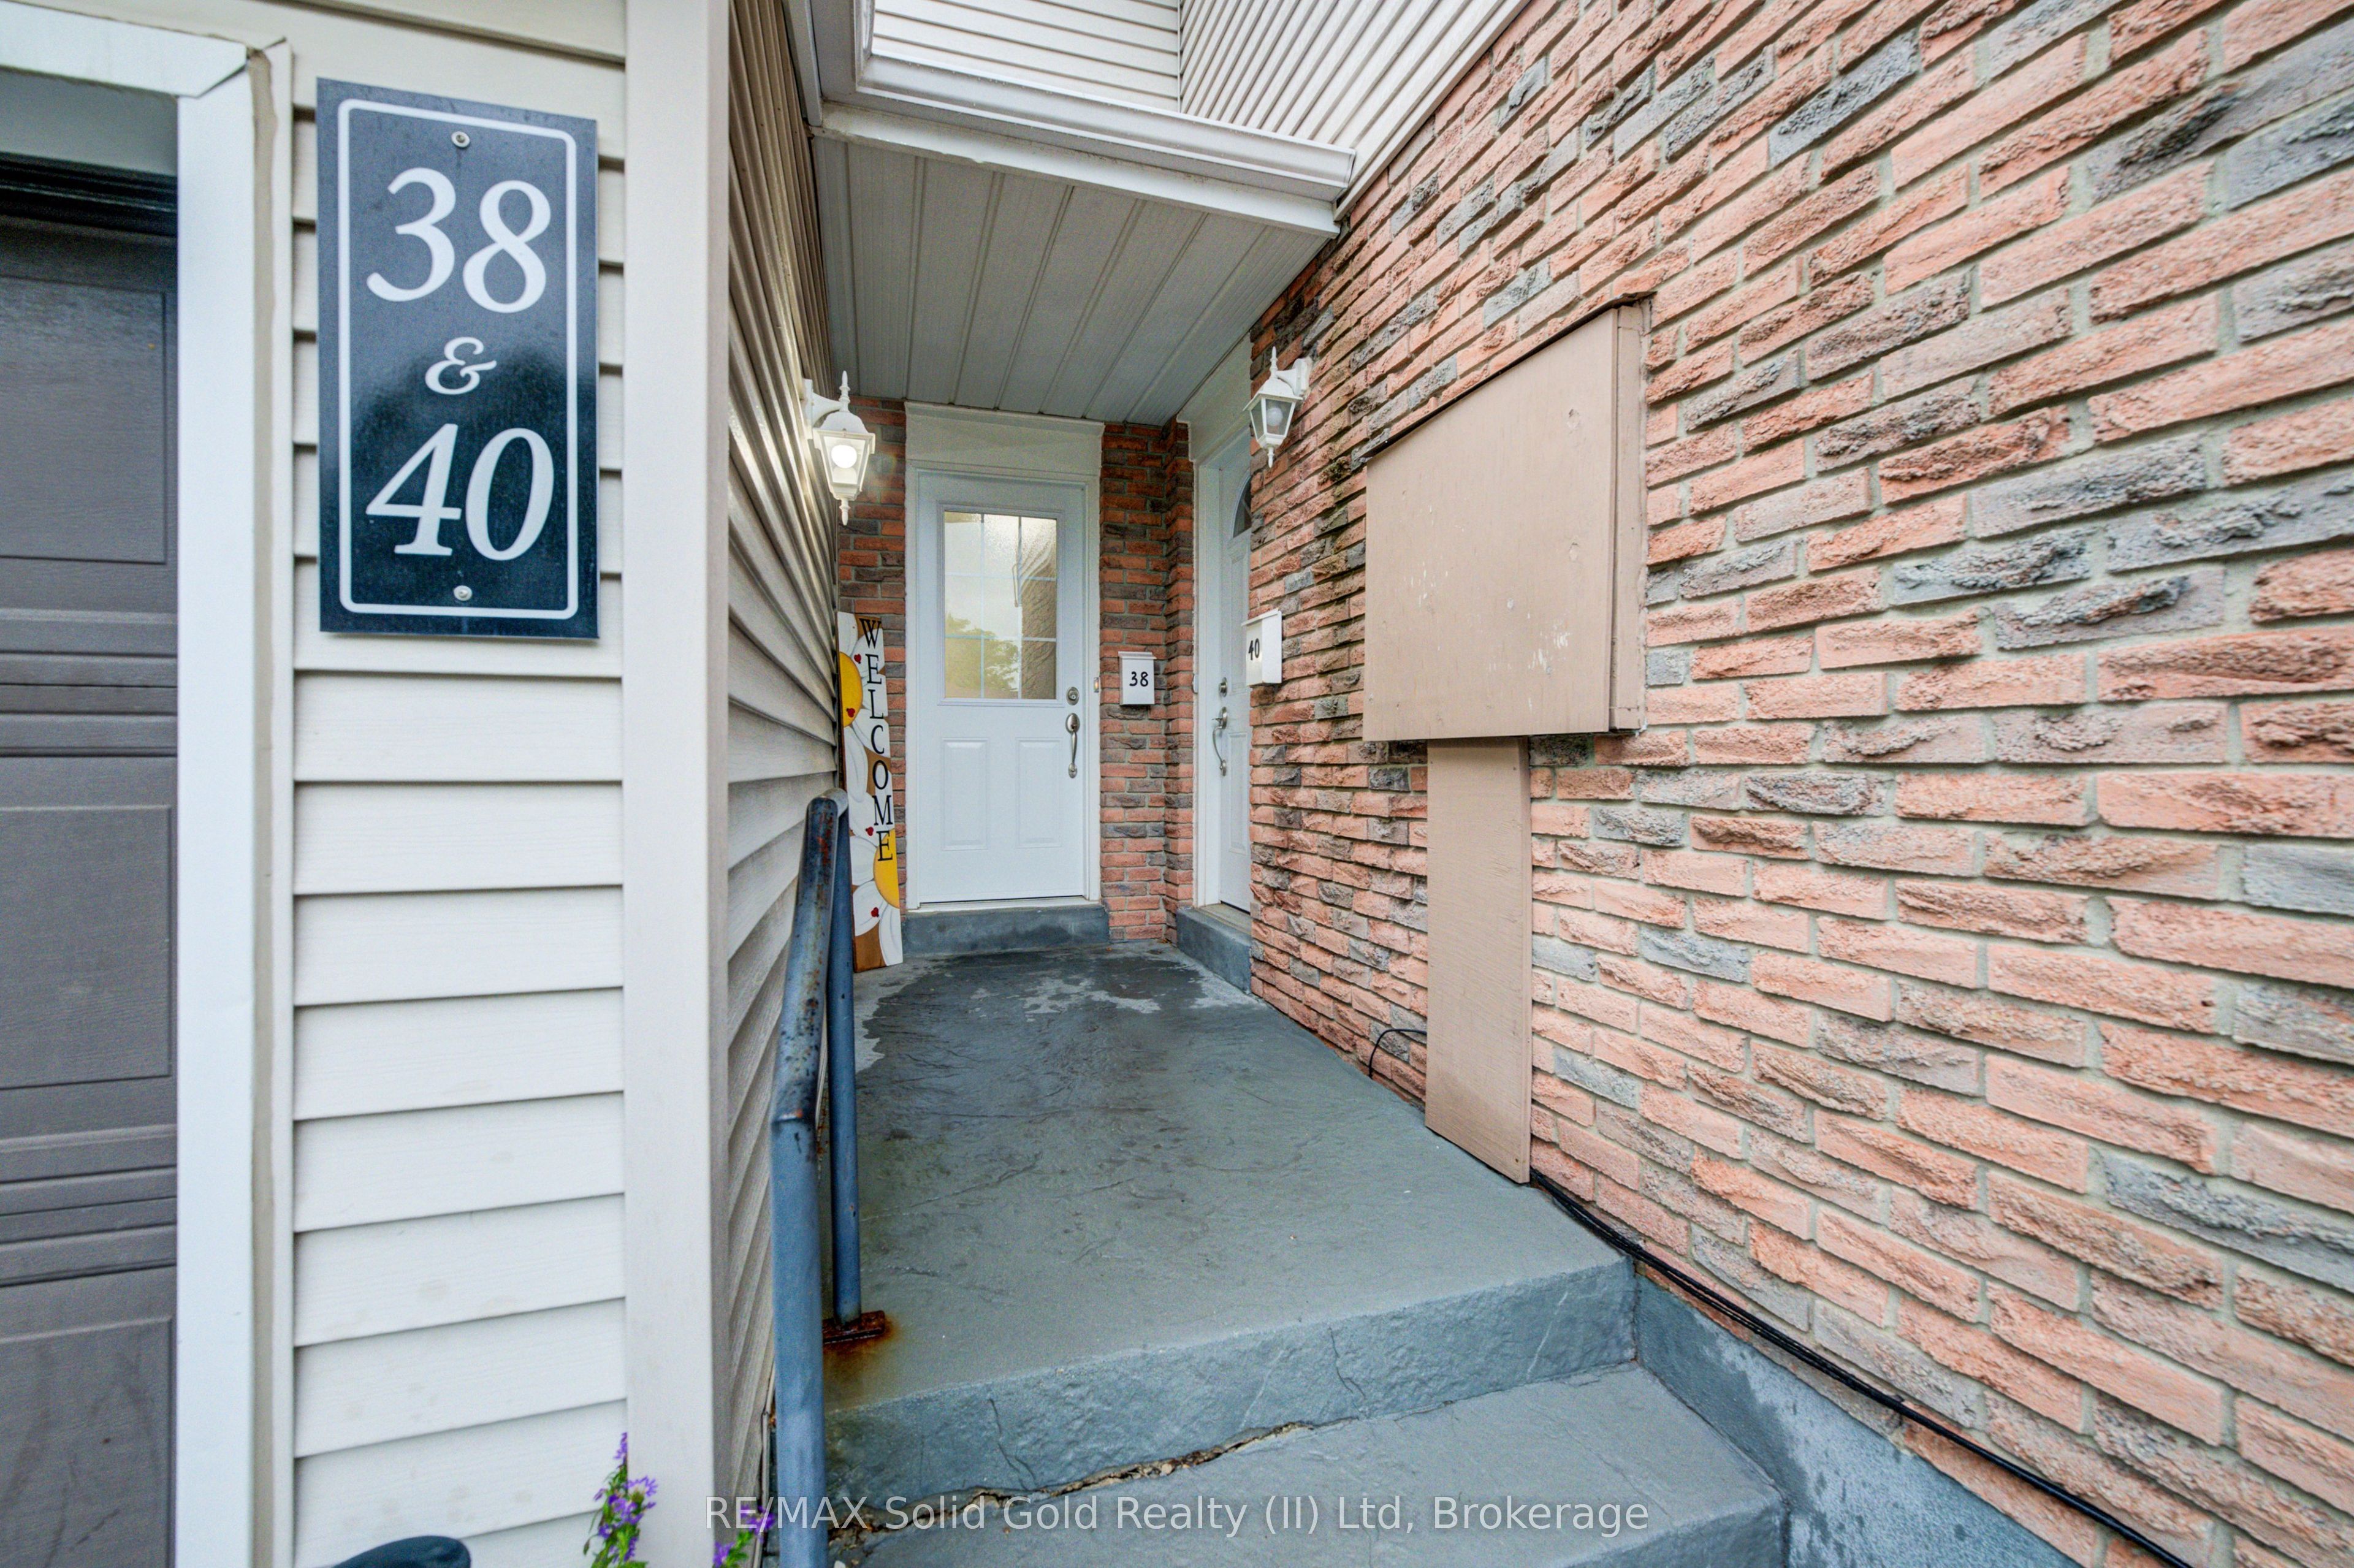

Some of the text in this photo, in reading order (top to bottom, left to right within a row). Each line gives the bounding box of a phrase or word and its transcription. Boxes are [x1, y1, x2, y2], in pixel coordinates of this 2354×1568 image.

[367, 167, 551, 314] 38
[424, 336, 497, 395] &
[365, 422, 555, 561] 40
[1129, 671, 1149, 687] 38
[1248, 638, 1260, 661] 40
[859, 617, 893, 861] WELCOME
